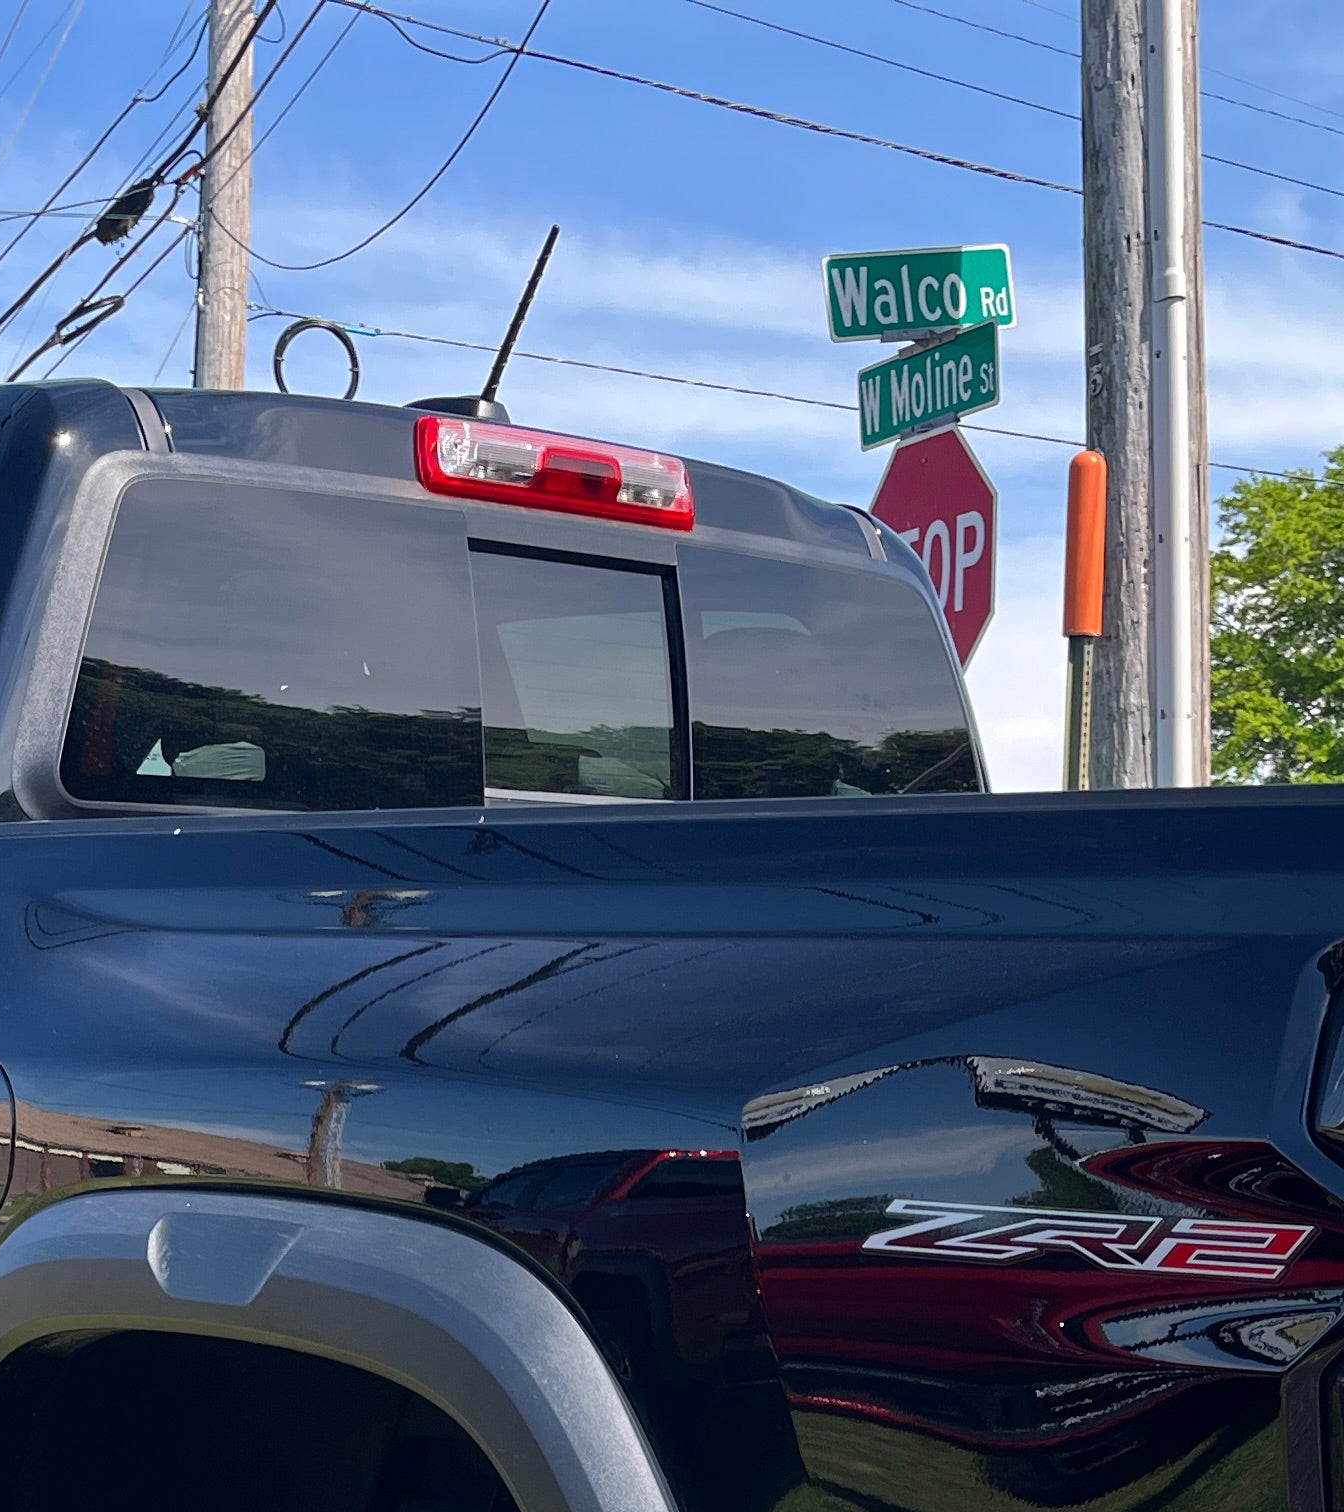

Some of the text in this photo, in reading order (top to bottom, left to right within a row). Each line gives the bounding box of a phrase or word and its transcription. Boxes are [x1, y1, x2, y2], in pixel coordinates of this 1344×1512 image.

[831, 264, 1009, 328] Walco Rd
[861, 351, 995, 436] W Moline St
[897, 510, 986, 612] OP
[860, 1199, 1319, 1281] ZR2
